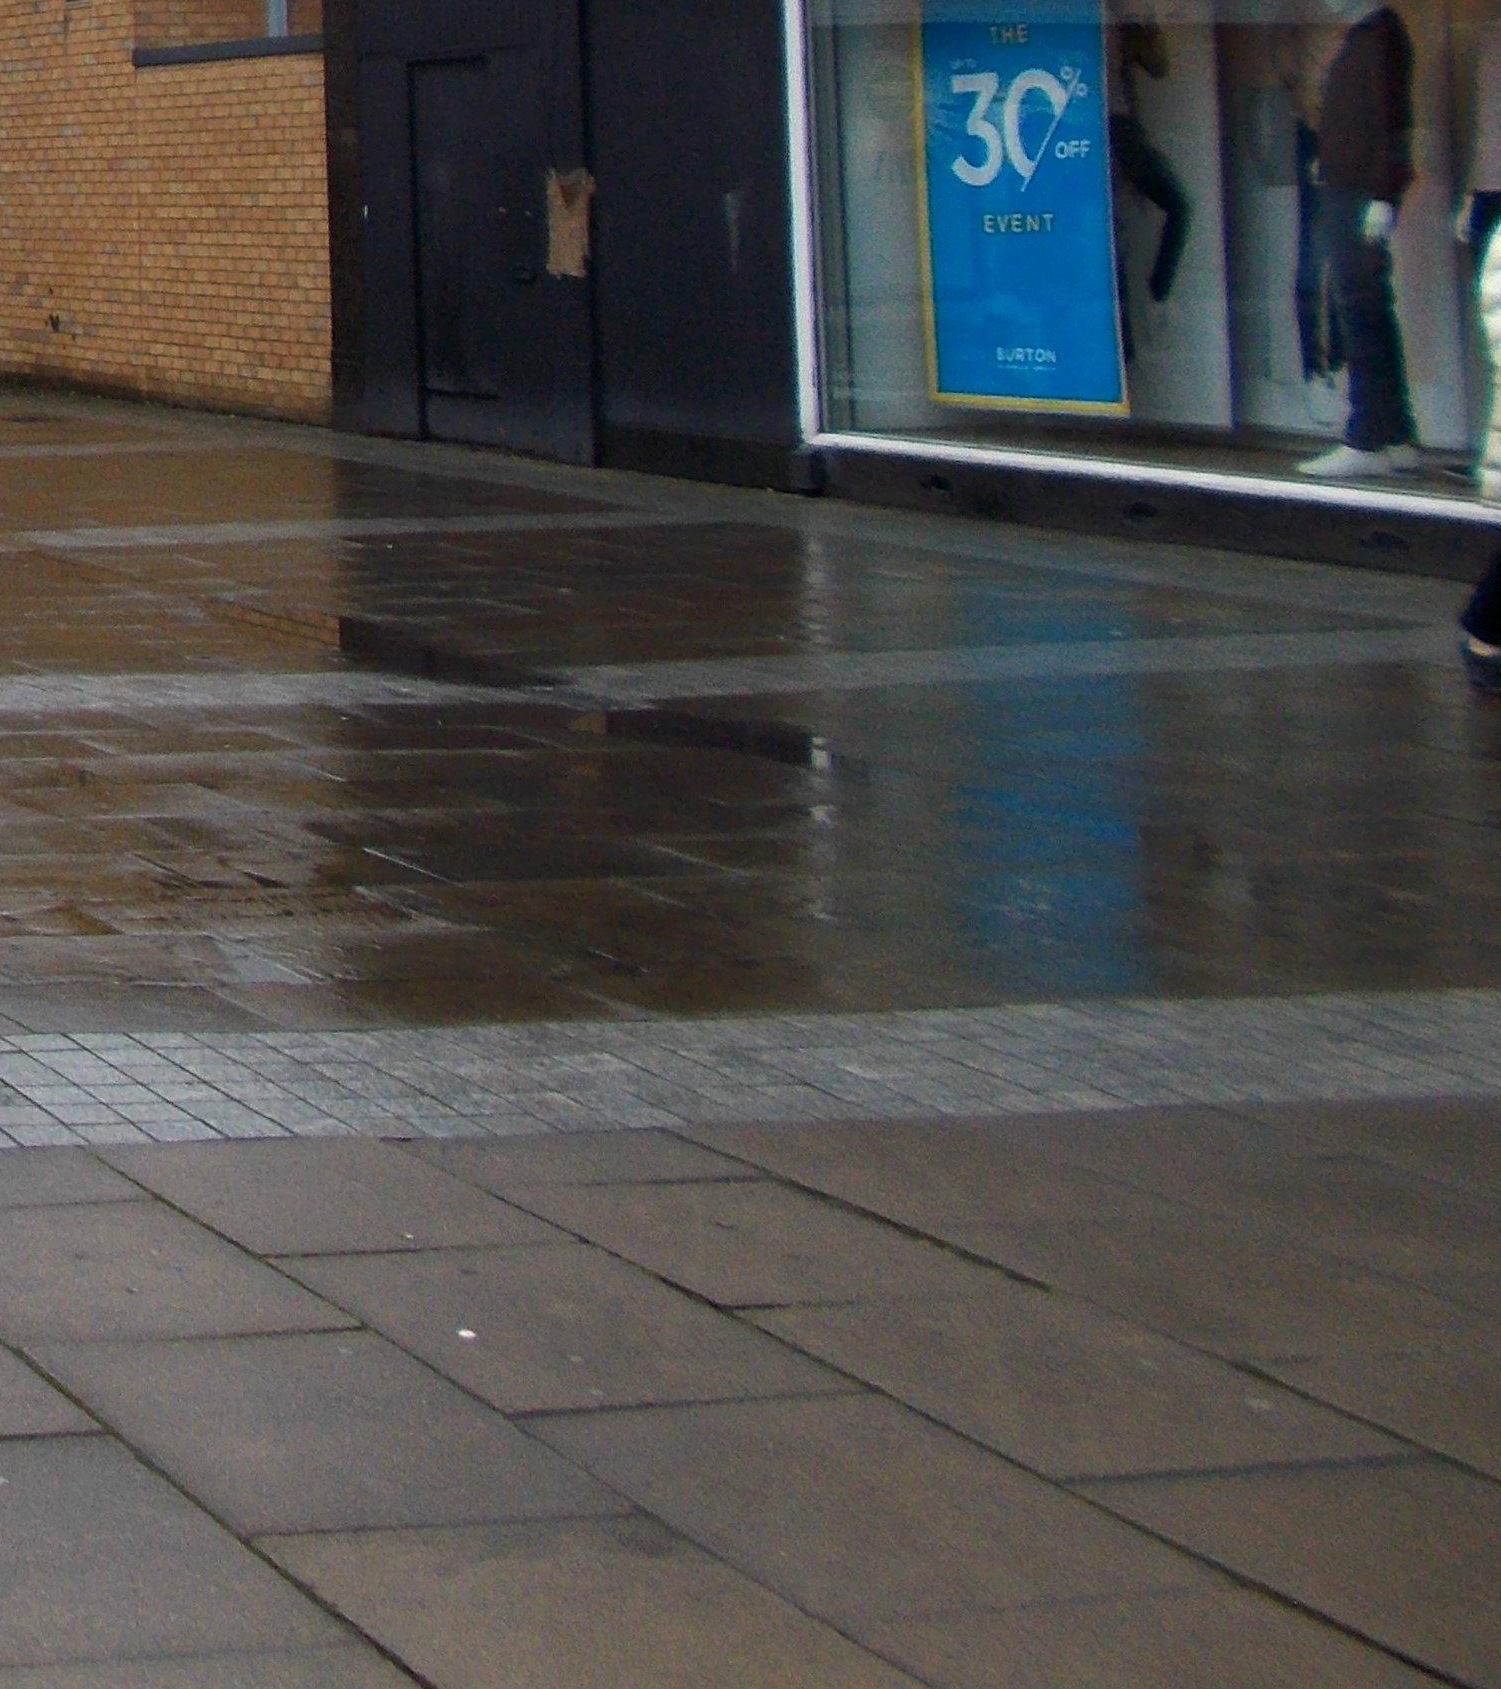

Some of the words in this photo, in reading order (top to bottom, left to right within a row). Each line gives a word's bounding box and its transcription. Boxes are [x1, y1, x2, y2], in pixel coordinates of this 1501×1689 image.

[989, 23, 1029, 45] THE
[1054, 139, 1091, 159] OFF
[983, 213, 1054, 233] EVENT
[996, 346, 1057, 363] BURTON
